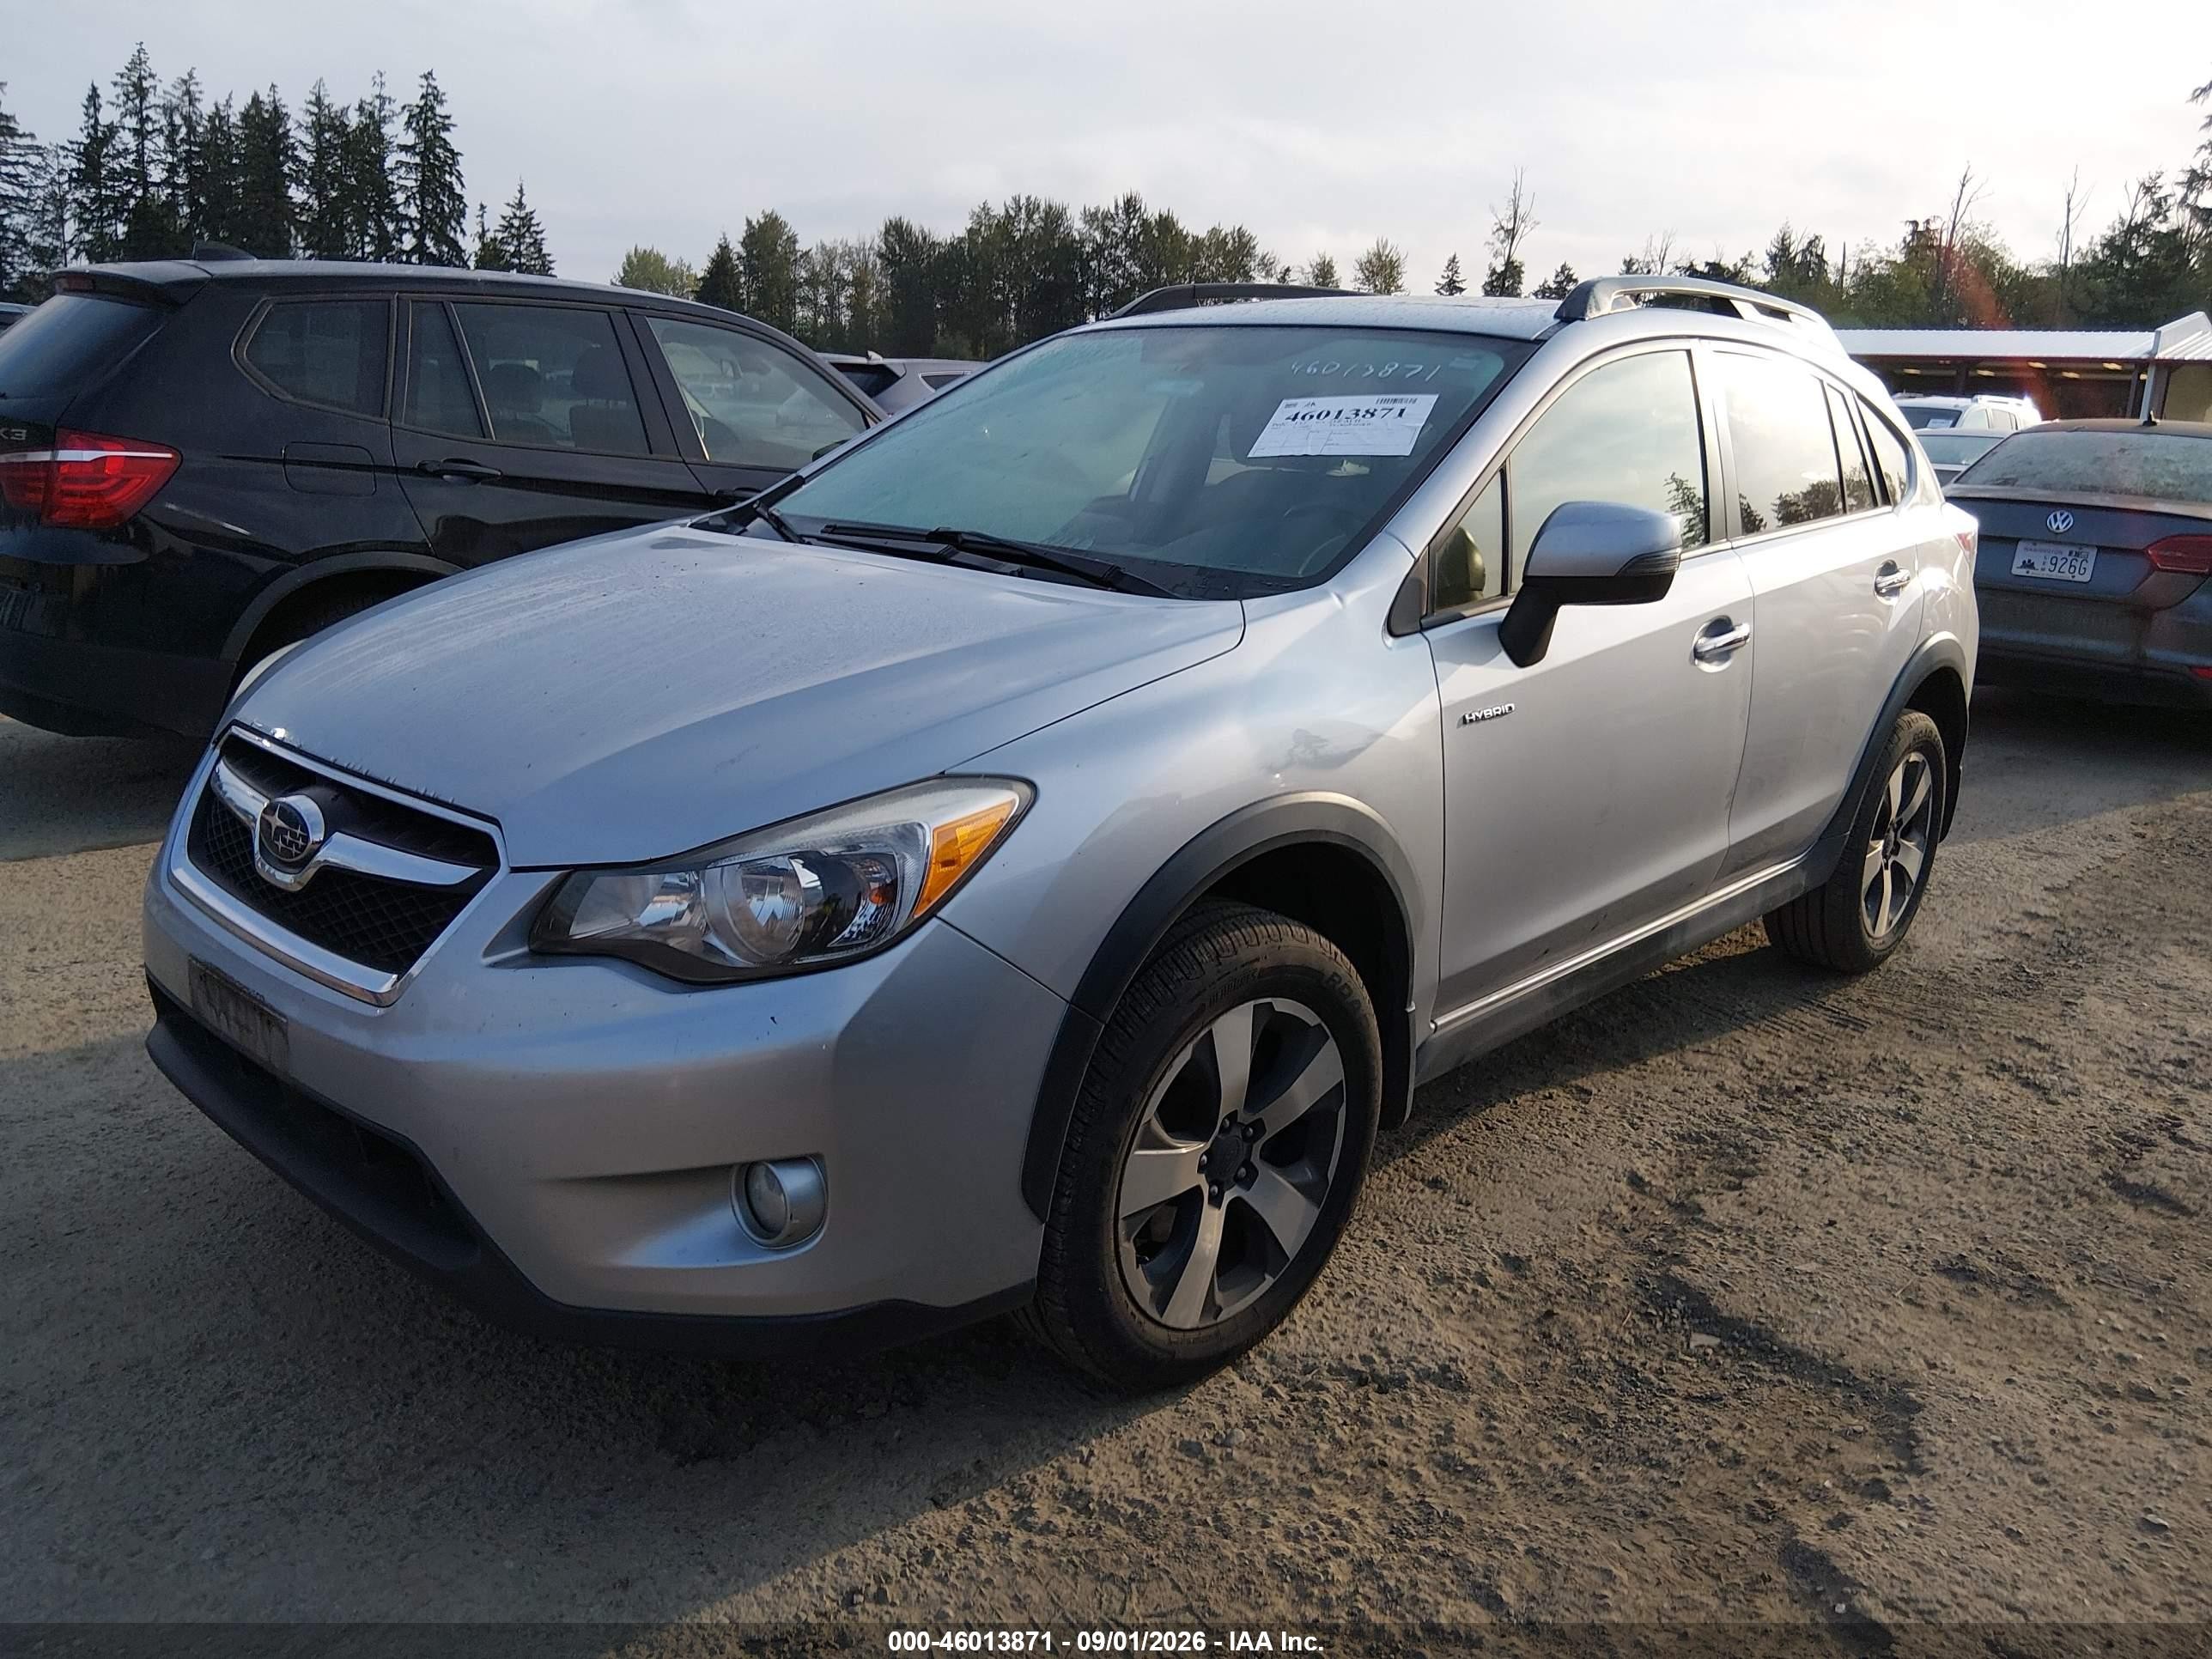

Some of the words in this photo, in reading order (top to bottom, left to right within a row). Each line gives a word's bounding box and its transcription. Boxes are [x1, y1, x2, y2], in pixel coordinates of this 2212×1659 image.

[1291, 360, 1441, 381] 46013871
[1285, 406, 1407, 422] 46013871
[2048, 556, 2088, 575] 926G
[1463, 703, 1515, 723] HYBRID
